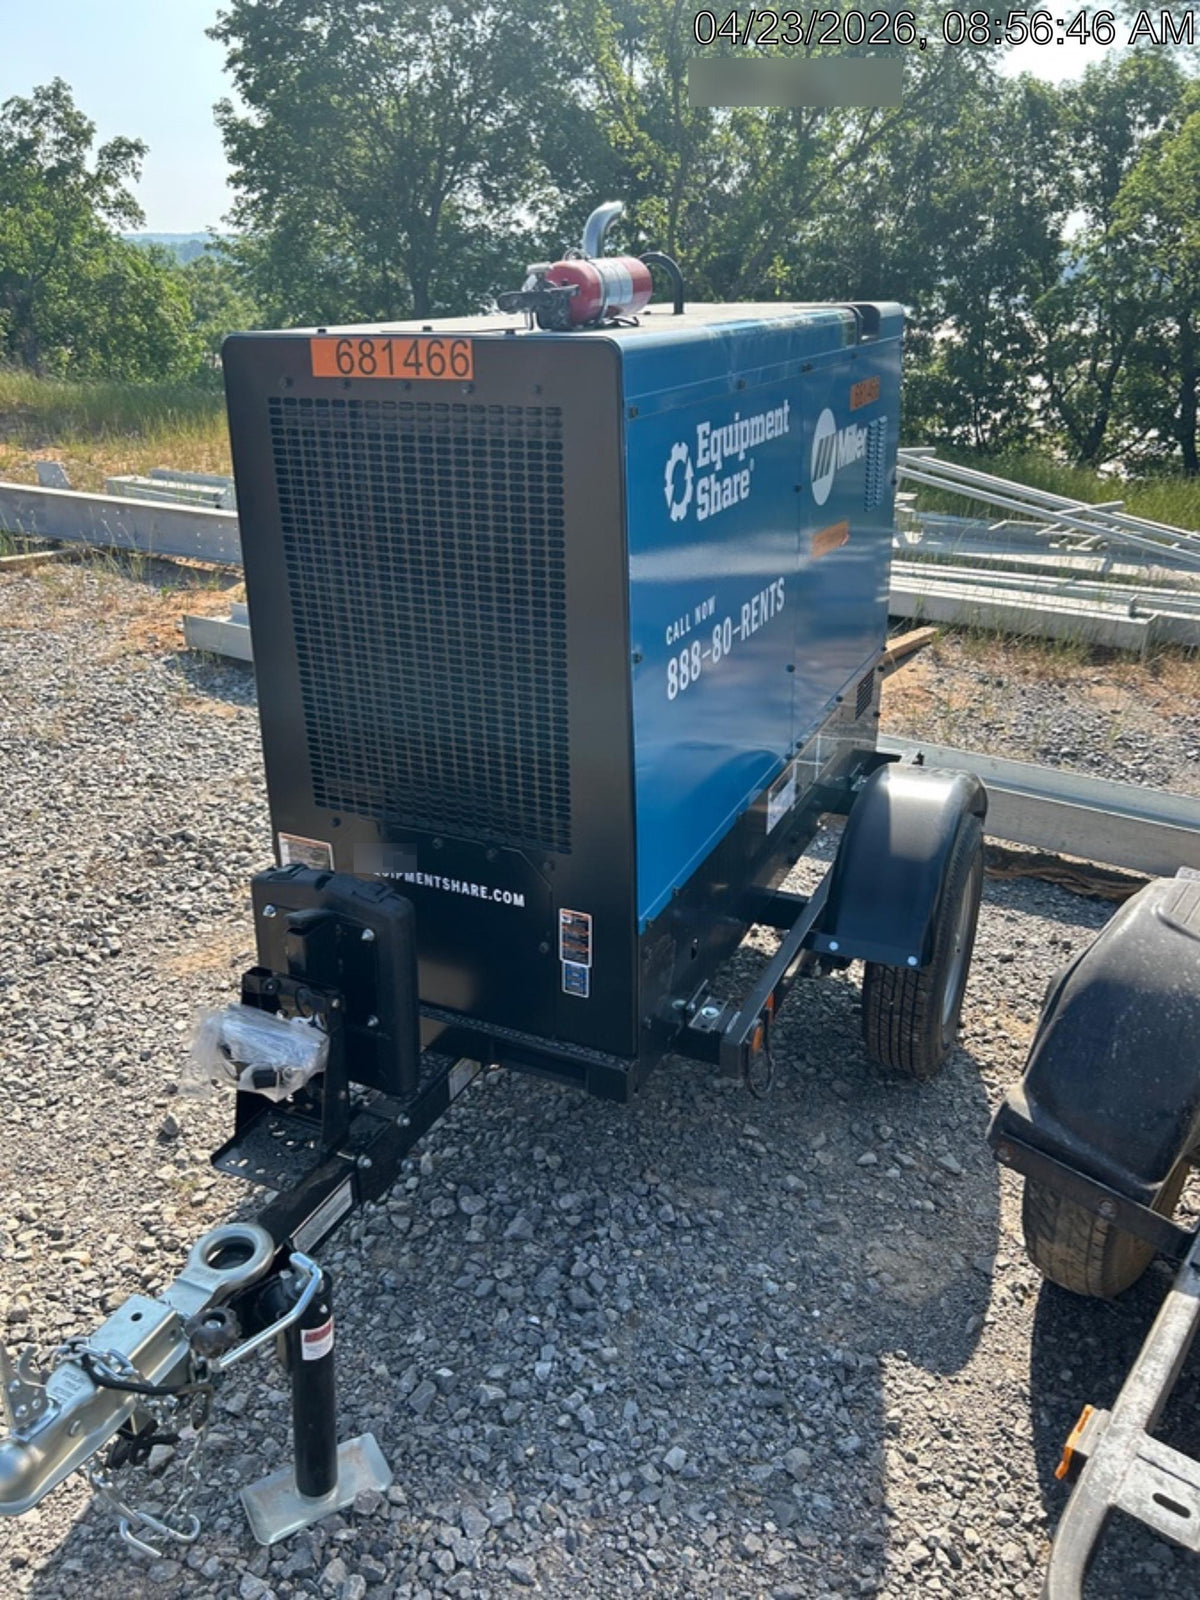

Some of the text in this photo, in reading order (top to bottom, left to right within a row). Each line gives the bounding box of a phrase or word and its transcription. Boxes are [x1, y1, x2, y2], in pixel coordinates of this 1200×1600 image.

[336, 339, 470, 377] 681466
[696, 399, 790, 471] Equipment
[696, 468, 750, 521] Share
[665, 595, 716, 646] CALL NOW
[667, 576, 785, 701] 888-80-RENTS
